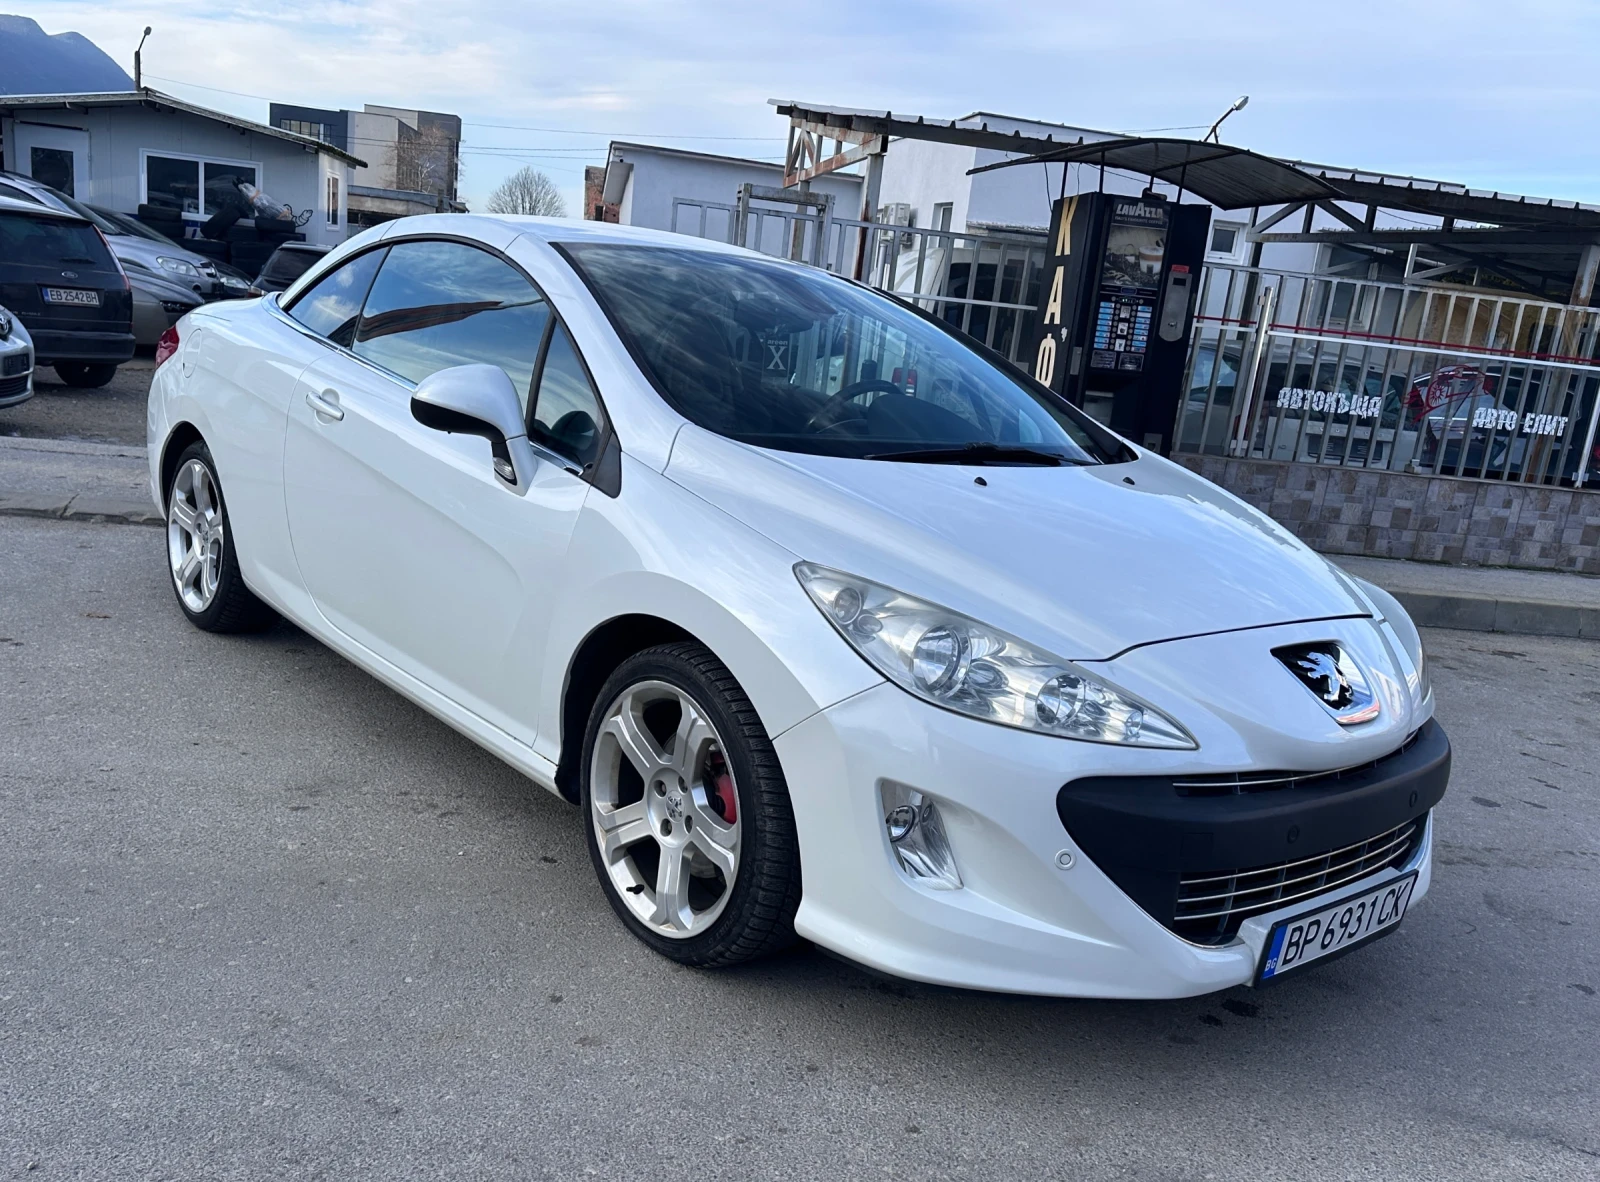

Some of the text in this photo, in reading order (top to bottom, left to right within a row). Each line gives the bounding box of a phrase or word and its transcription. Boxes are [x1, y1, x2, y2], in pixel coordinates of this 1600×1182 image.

[1116, 202, 1163, 219] LAVAZZA
[766, 345, 788, 370] X
[1276, 387, 1382, 419] АВТОКЪЩА
[1472, 407, 1569, 437] АВТО ЕЛИТ
[1264, 958, 1278, 972] BG
